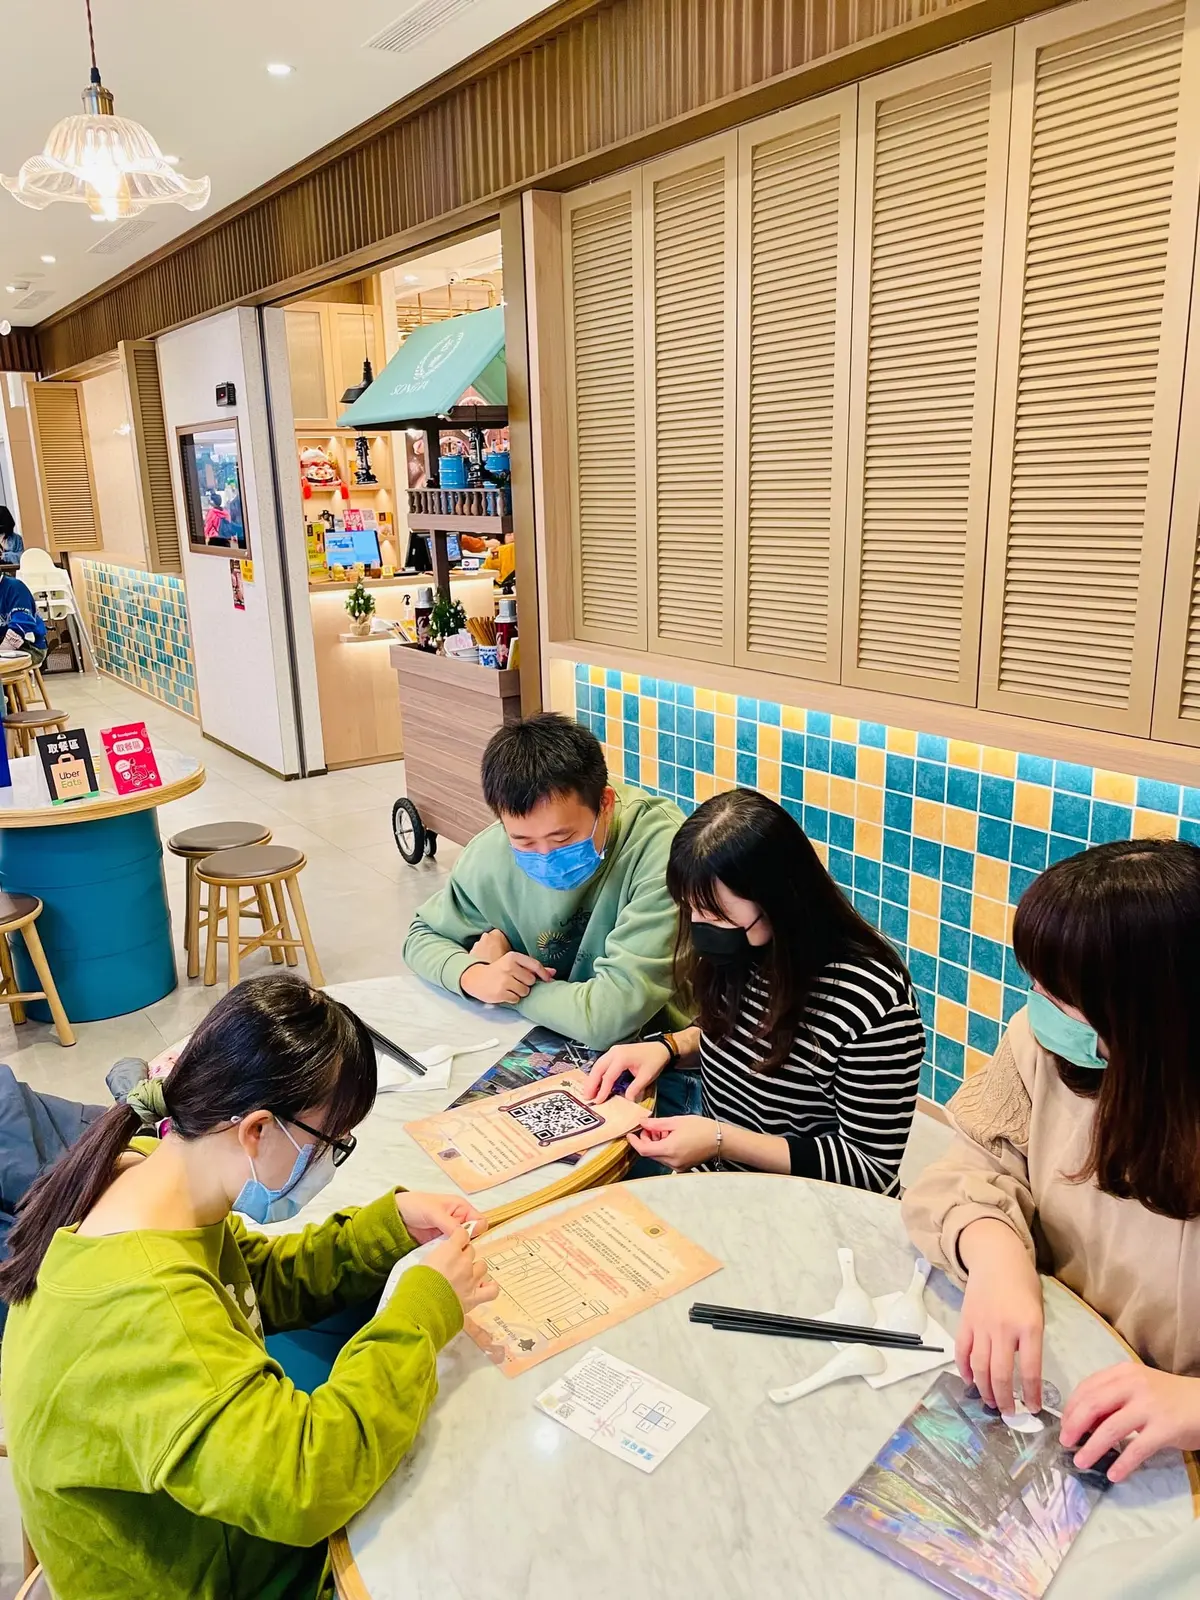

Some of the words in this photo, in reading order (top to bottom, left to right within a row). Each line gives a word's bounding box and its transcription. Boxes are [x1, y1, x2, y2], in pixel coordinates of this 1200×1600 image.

[47, 739, 80, 754] 取餐區
[59, 770, 80, 781] Uber
[60, 779, 83, 789] Eats
